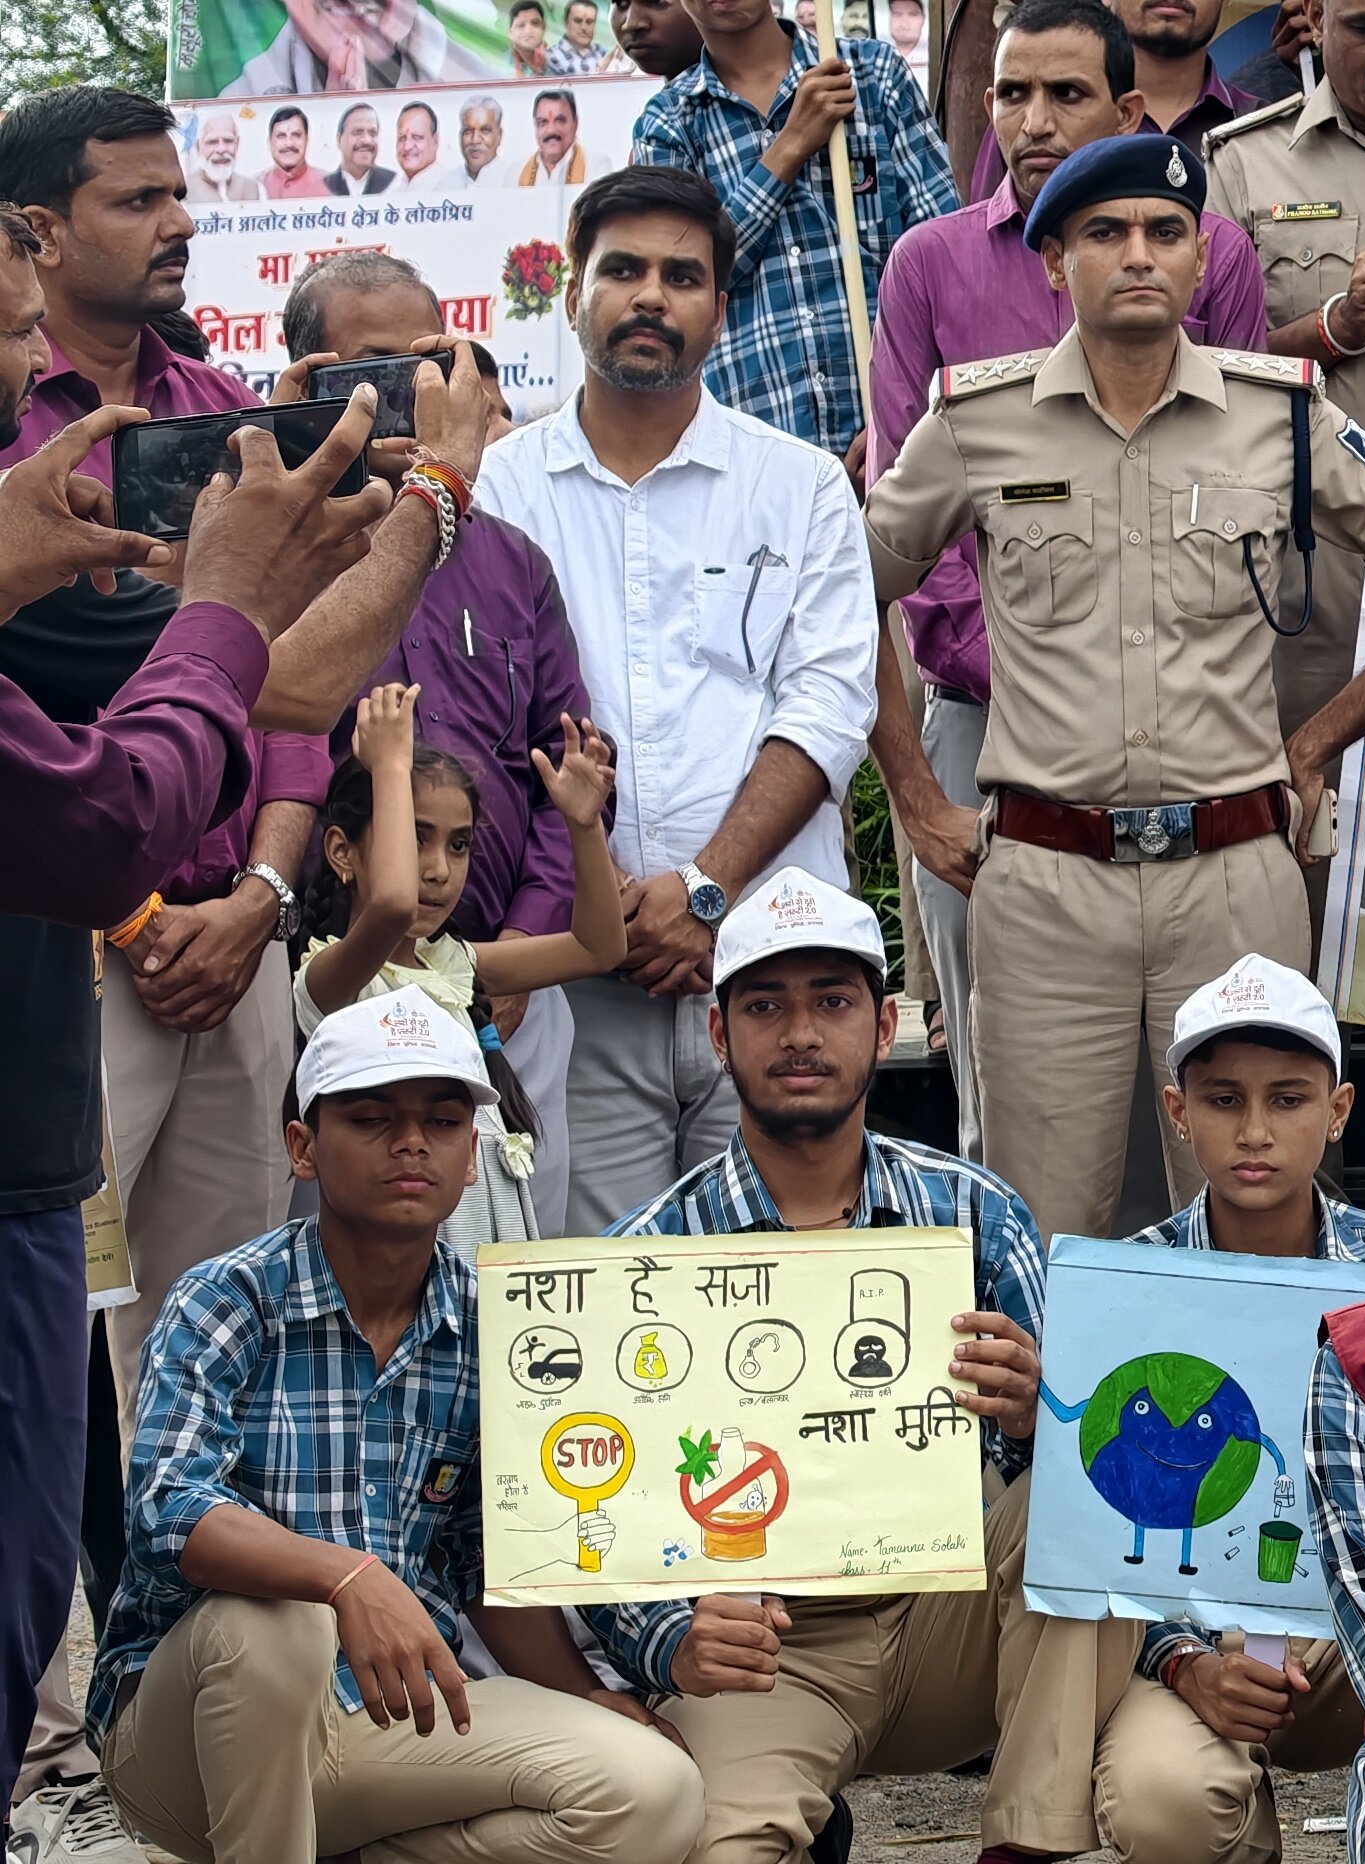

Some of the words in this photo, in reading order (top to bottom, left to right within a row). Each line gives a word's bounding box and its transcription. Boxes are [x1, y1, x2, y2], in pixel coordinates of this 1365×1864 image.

[238, 210, 287, 232] आलोट
[351, 206, 379, 228] क्षेत्र
[387, 204, 400, 225] के
[405, 201, 474, 225] लोकप्रिय
[506, 1268, 597, 1314] नशा
[624, 1256, 673, 1317] है
[695, 1263, 779, 1308] सज़ा
[799, 1408, 876, 1443] नशा
[895, 1385, 972, 1451] मुक्ति
[557, 1434, 624, 1468] STOP
